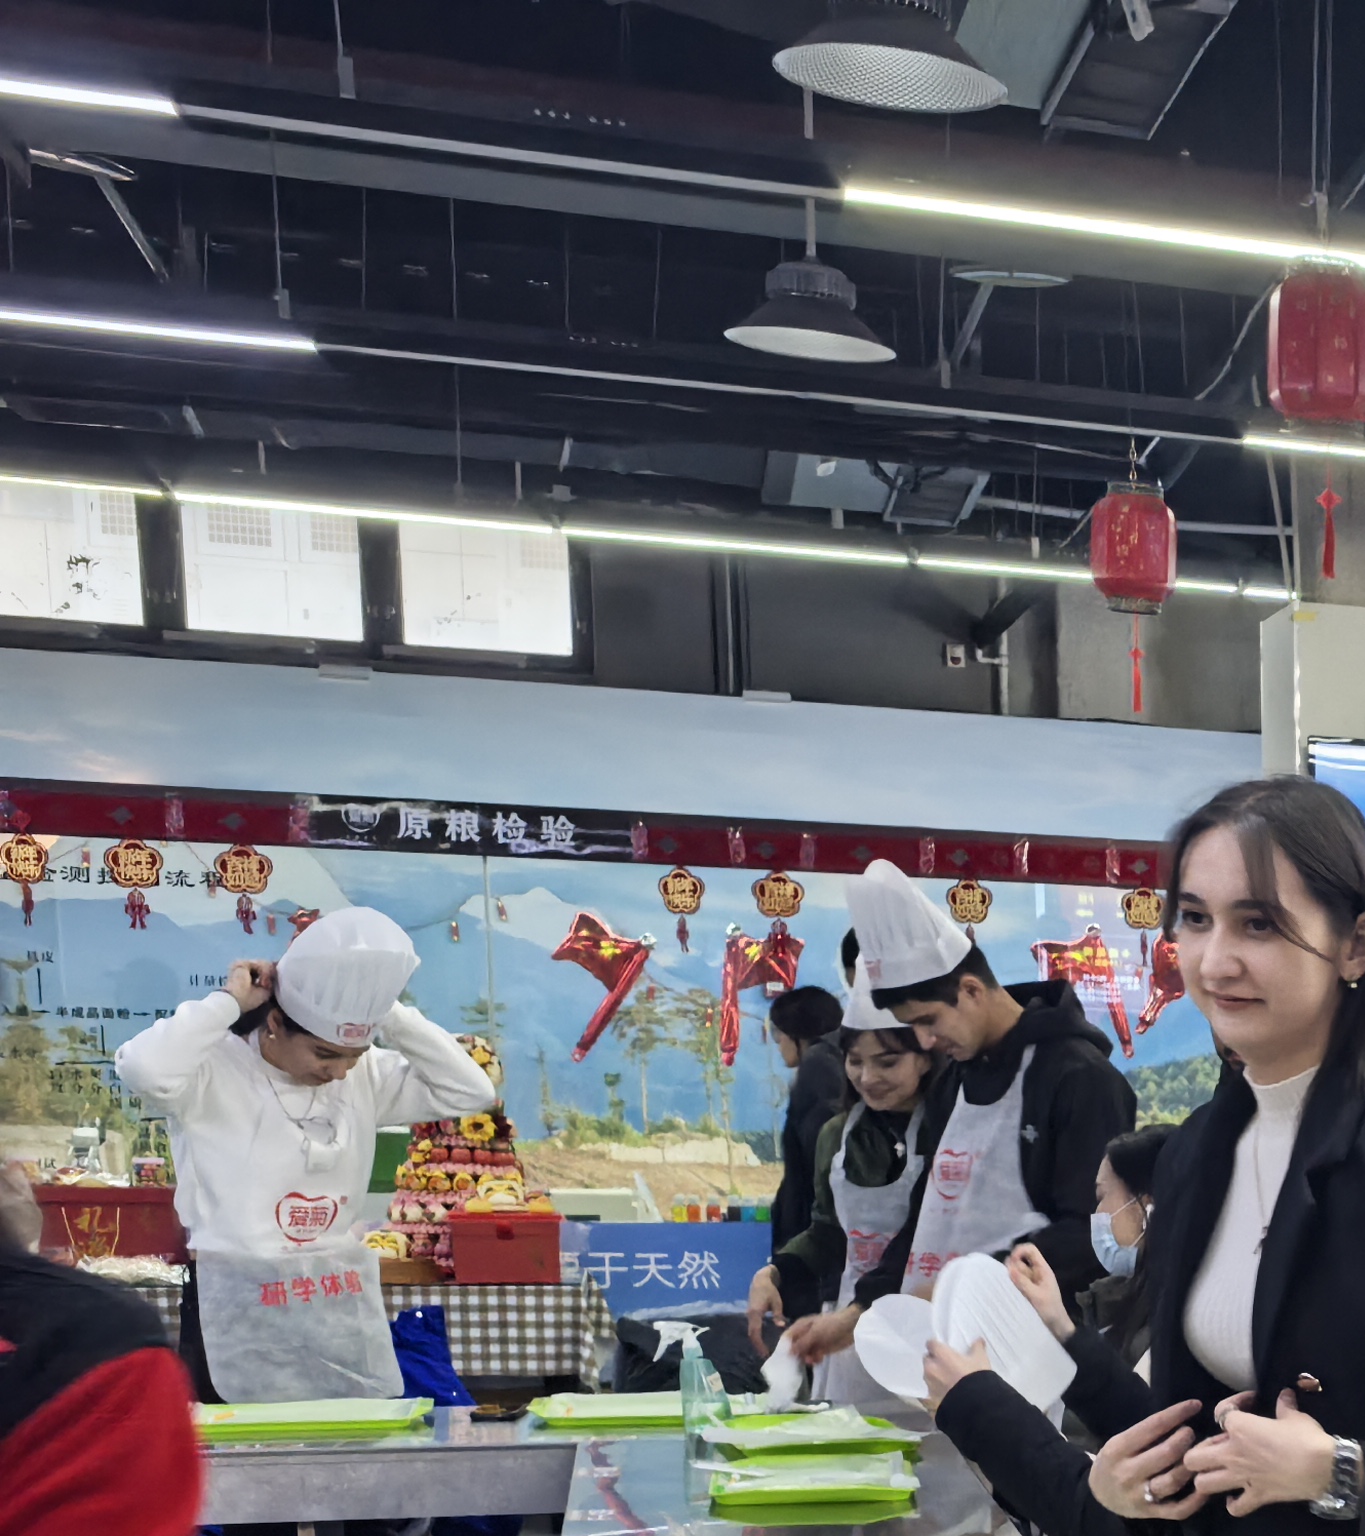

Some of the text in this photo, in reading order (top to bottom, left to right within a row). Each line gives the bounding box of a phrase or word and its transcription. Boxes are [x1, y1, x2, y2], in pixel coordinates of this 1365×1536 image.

[397, 808, 577, 849] 原粮检验
[288, 1205, 329, 1228] 爱菊
